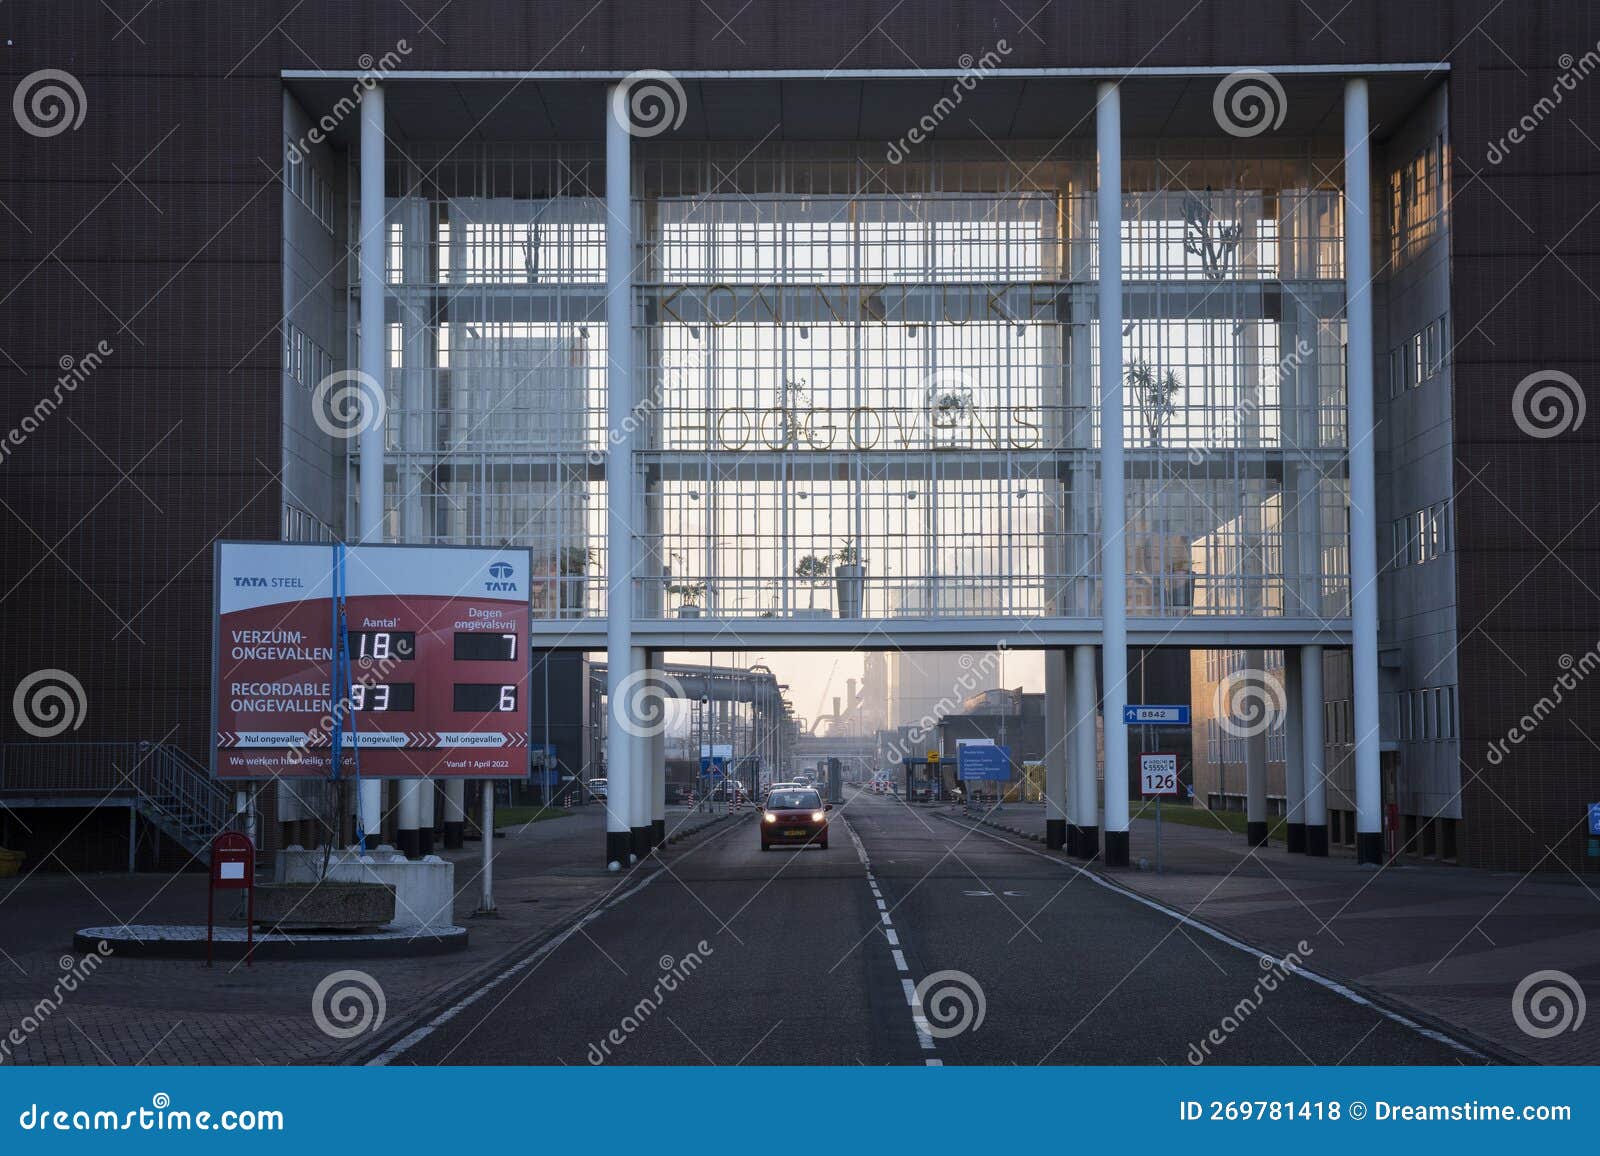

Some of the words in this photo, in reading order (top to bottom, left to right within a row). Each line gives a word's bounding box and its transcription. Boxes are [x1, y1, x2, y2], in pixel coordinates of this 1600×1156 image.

[234, 577, 267, 588] TATA
[272, 577, 304, 588] STEEL
[485, 582, 517, 592] TATA
[469, 607, 502, 618] Dagen
[454, 617, 516, 631] ongevalsvrij
[231, 630, 308, 644] VERZUIM-
[359, 633, 390, 659] 18
[502, 634, 516, 659] 7
[231, 647, 333, 660] ONGEVALLEN
[231, 683, 331, 696] RECORDABLE
[499, 685, 515, 711] 6
[230, 699, 332, 713] ONGEVALLEN
[245, 735, 259, 744] Nul
[362, 735, 405, 746] ongevallen
[445, 735, 458, 744] Nul
[460, 735, 502, 746] ongevallen
[230, 757, 244, 765] We
[245, 757, 279, 765] werken
[300, 757, 323, 767] veilig
[474, 760, 490, 770] April
[490, 760, 509, 769] 2022
[1146, 774, 1174, 789] 126
